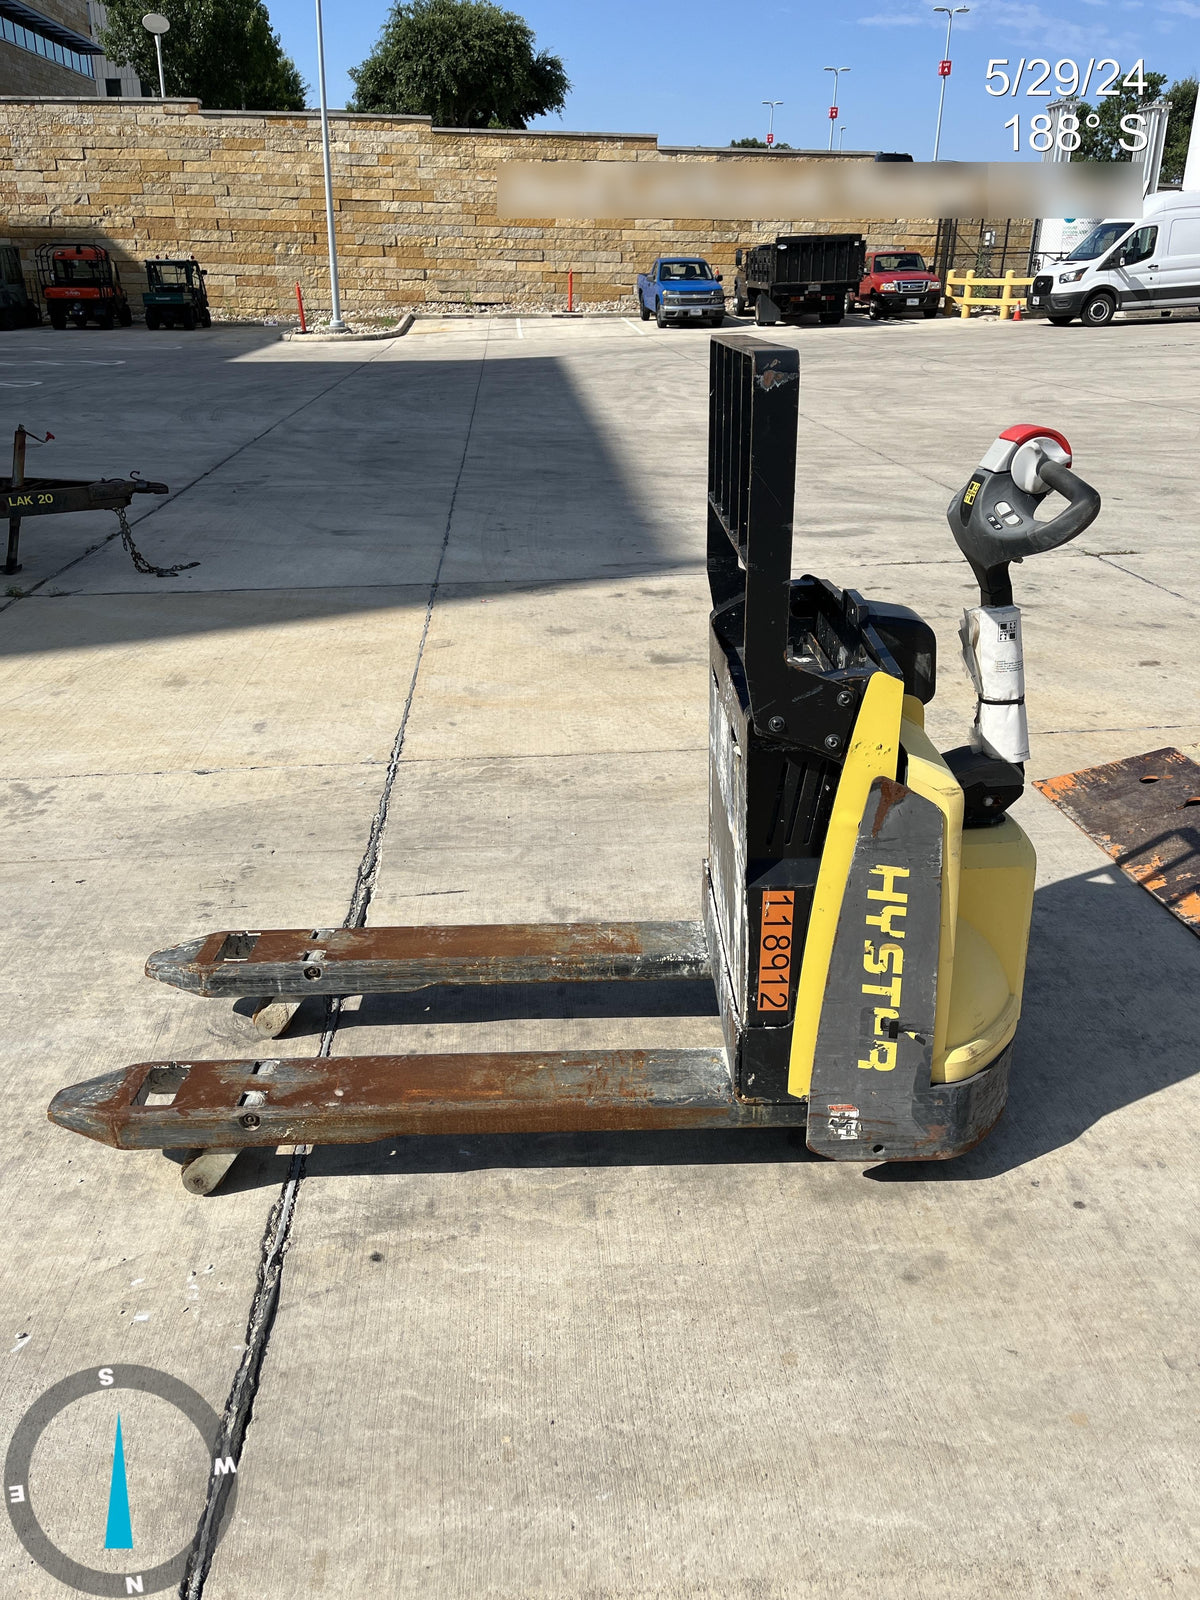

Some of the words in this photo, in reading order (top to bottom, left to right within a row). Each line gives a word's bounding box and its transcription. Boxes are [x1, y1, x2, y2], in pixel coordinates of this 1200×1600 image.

[8, 495, 33, 506] LAK
[37, 493, 54, 504] 20
[759, 894, 794, 1009] 118912
